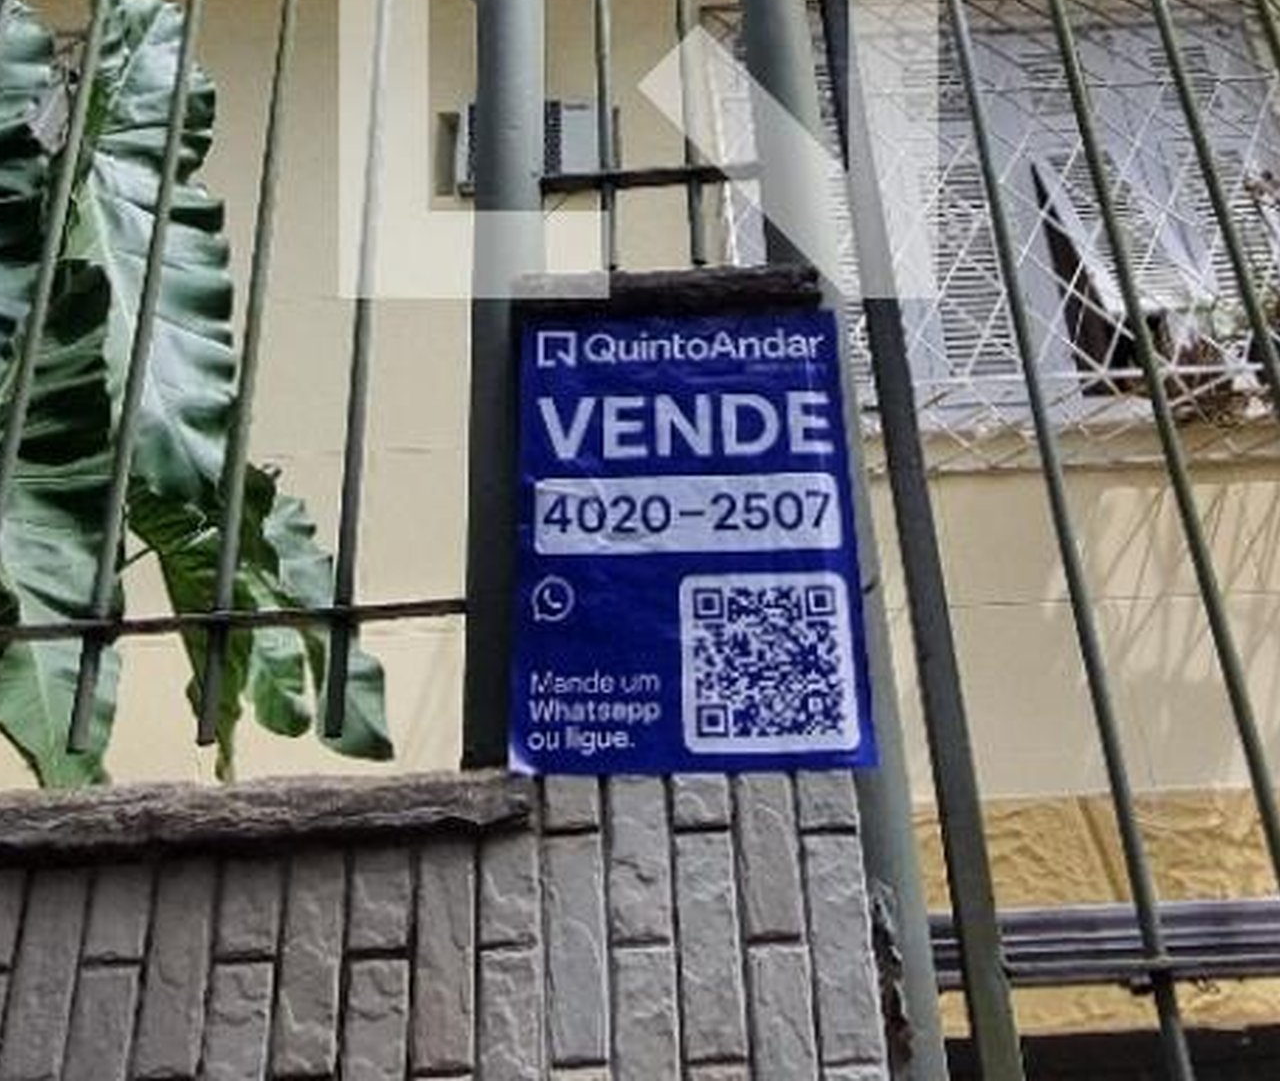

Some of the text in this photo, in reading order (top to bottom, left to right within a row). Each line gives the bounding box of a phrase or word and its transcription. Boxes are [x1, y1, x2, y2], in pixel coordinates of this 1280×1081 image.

[583, 328, 824, 364] QuintoAndar
[537, 391, 835, 461] VENDE
[543, 490, 831, 534] 4020-2507
[530, 669, 661, 695] Mande um
[528, 698, 661, 725] Whatsapp
[527, 725, 636, 756] ou ligue.
